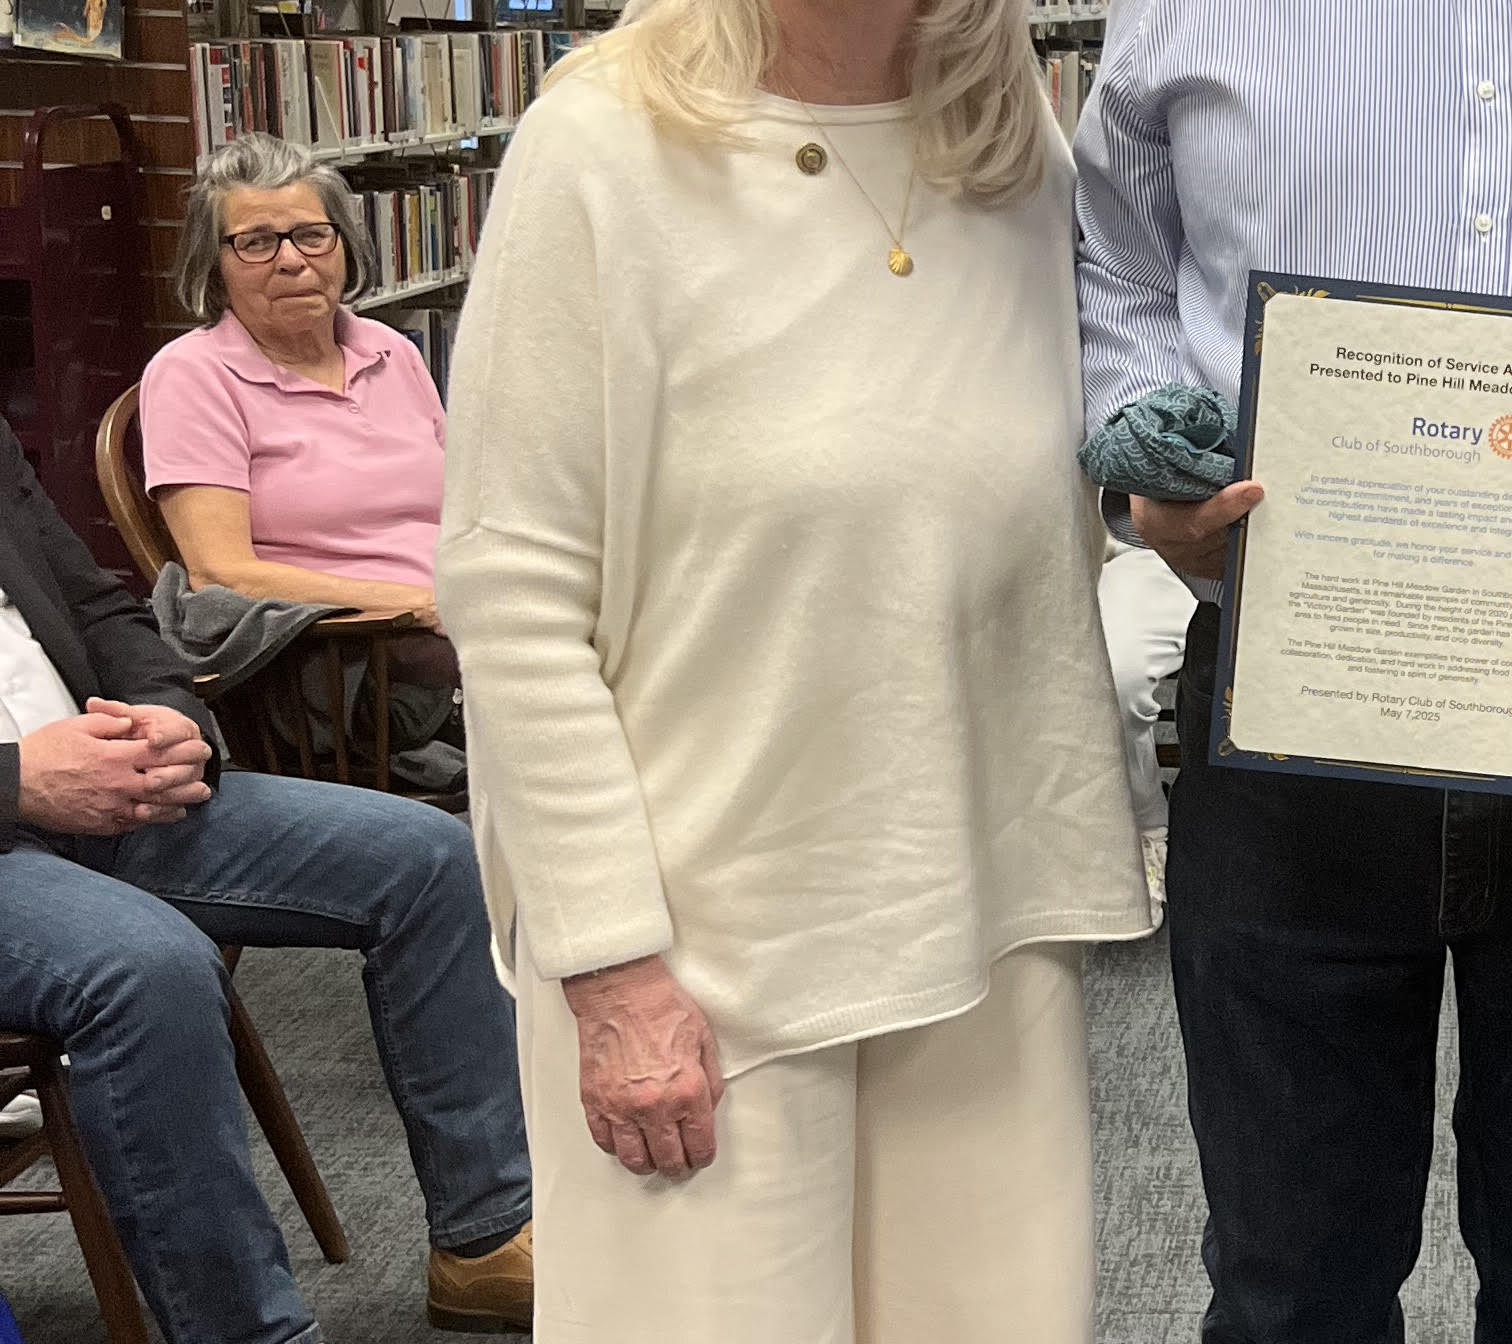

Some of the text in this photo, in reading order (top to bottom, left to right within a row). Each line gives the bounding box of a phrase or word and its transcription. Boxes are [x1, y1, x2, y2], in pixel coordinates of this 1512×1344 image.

[1335, 346, 1423, 367] Recognition
[1426, 356, 1442, 368] of
[1445, 357, 1499, 375] Service
[1309, 362, 1383, 382] Presented
[1386, 370, 1401, 384] to
[1405, 372, 1438, 387] Pine
[1441, 375, 1465, 390] Hill
[1411, 416, 1483, 445] Rotary
[1331, 435, 1481, 464] Club of Southborough
[1299, 684, 1354, 700] Presented
[1355, 690, 1369, 703] by
[1371, 691, 1407, 707] Rotary
[1407, 695, 1433, 707] Club
[1434, 698, 1446, 709] of
[1379, 706, 1403, 720] May
